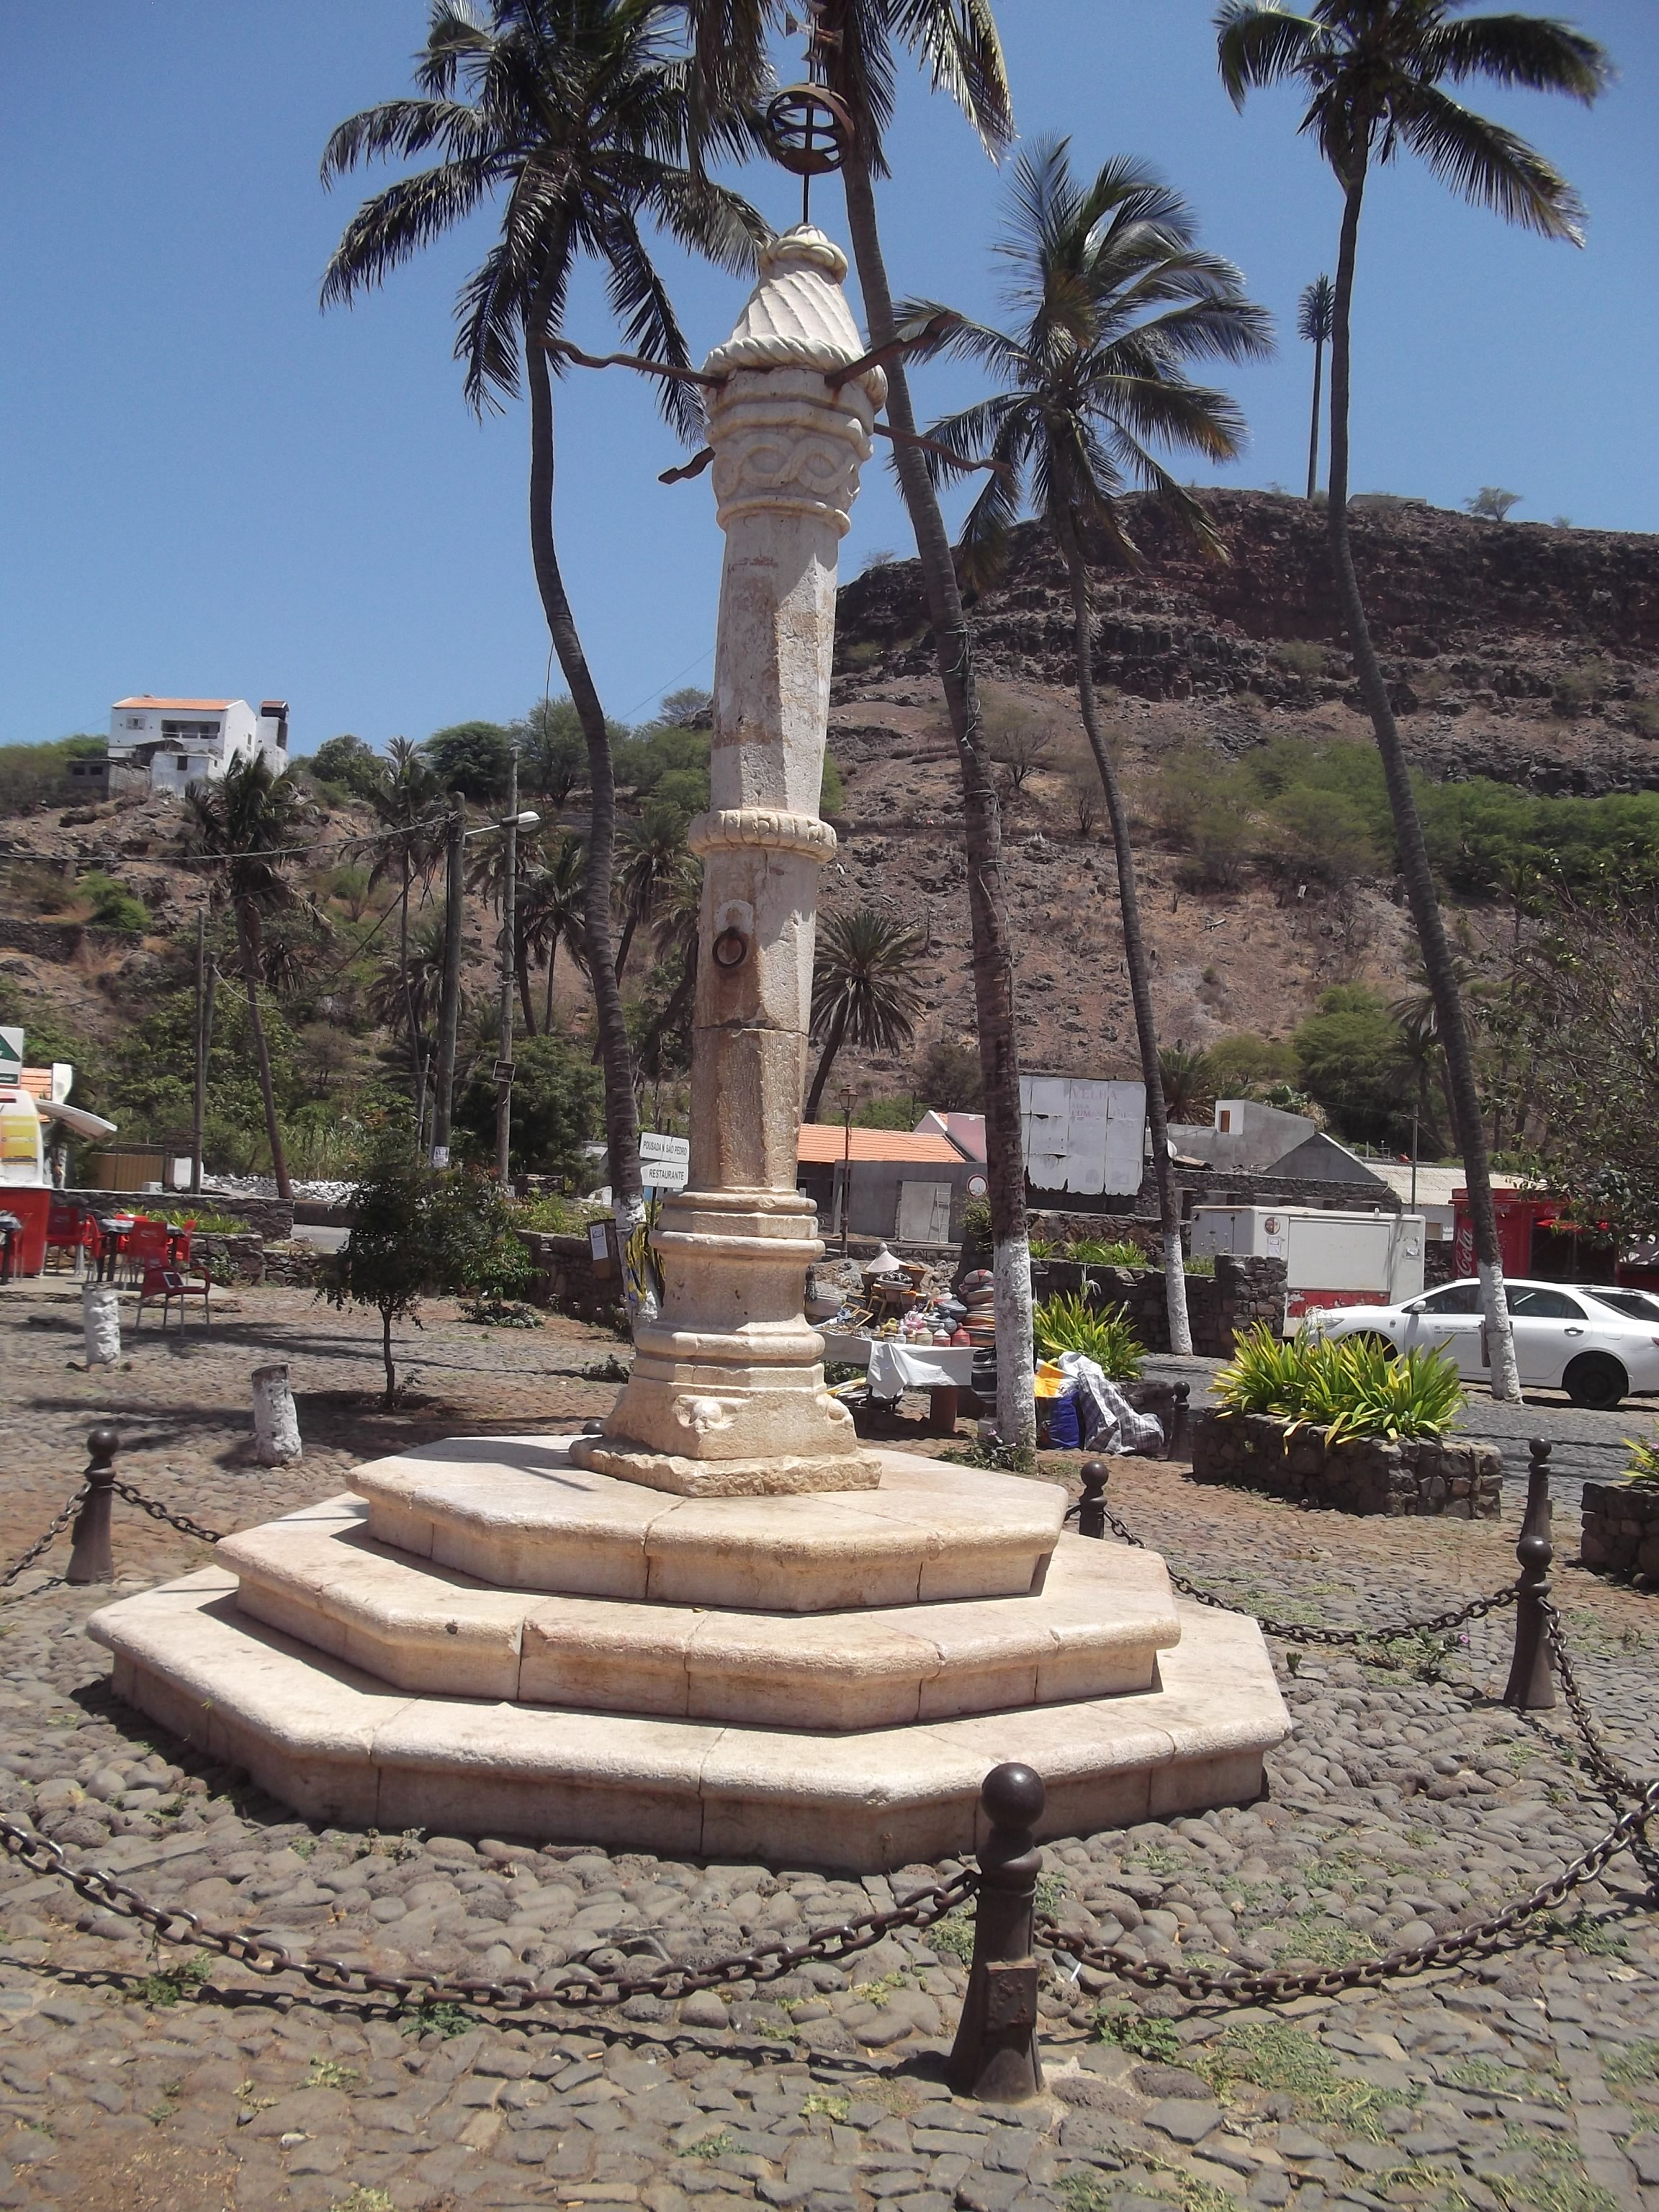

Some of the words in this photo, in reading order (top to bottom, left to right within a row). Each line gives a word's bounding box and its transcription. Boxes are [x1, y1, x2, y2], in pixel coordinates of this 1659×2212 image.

[643, 1140, 662, 1152] POUSADA
[675, 1146, 688, 1156] PEDRO
[649, 1169, 685, 1181] RESTAURANTE
